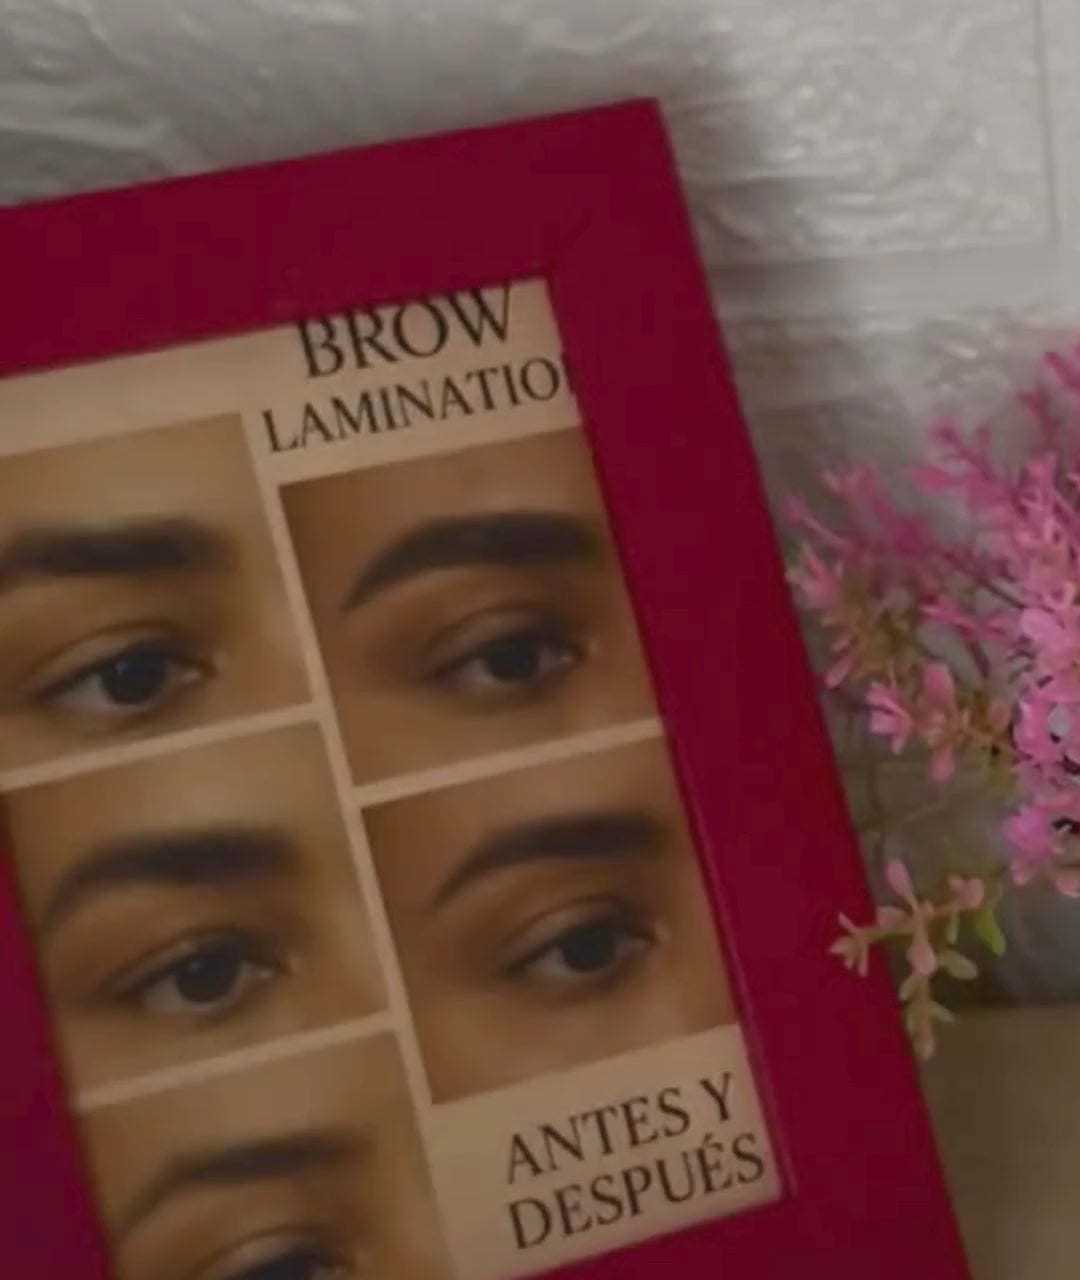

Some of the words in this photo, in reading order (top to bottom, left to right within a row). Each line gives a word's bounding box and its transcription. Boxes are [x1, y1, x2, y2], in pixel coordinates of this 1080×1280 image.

[296, 286, 514, 379] BROW
[506, 1086, 693, 1184] ANTES
[699, 1072, 734, 1121] Y
[508, 1132, 765, 1249] DESPUÉS
